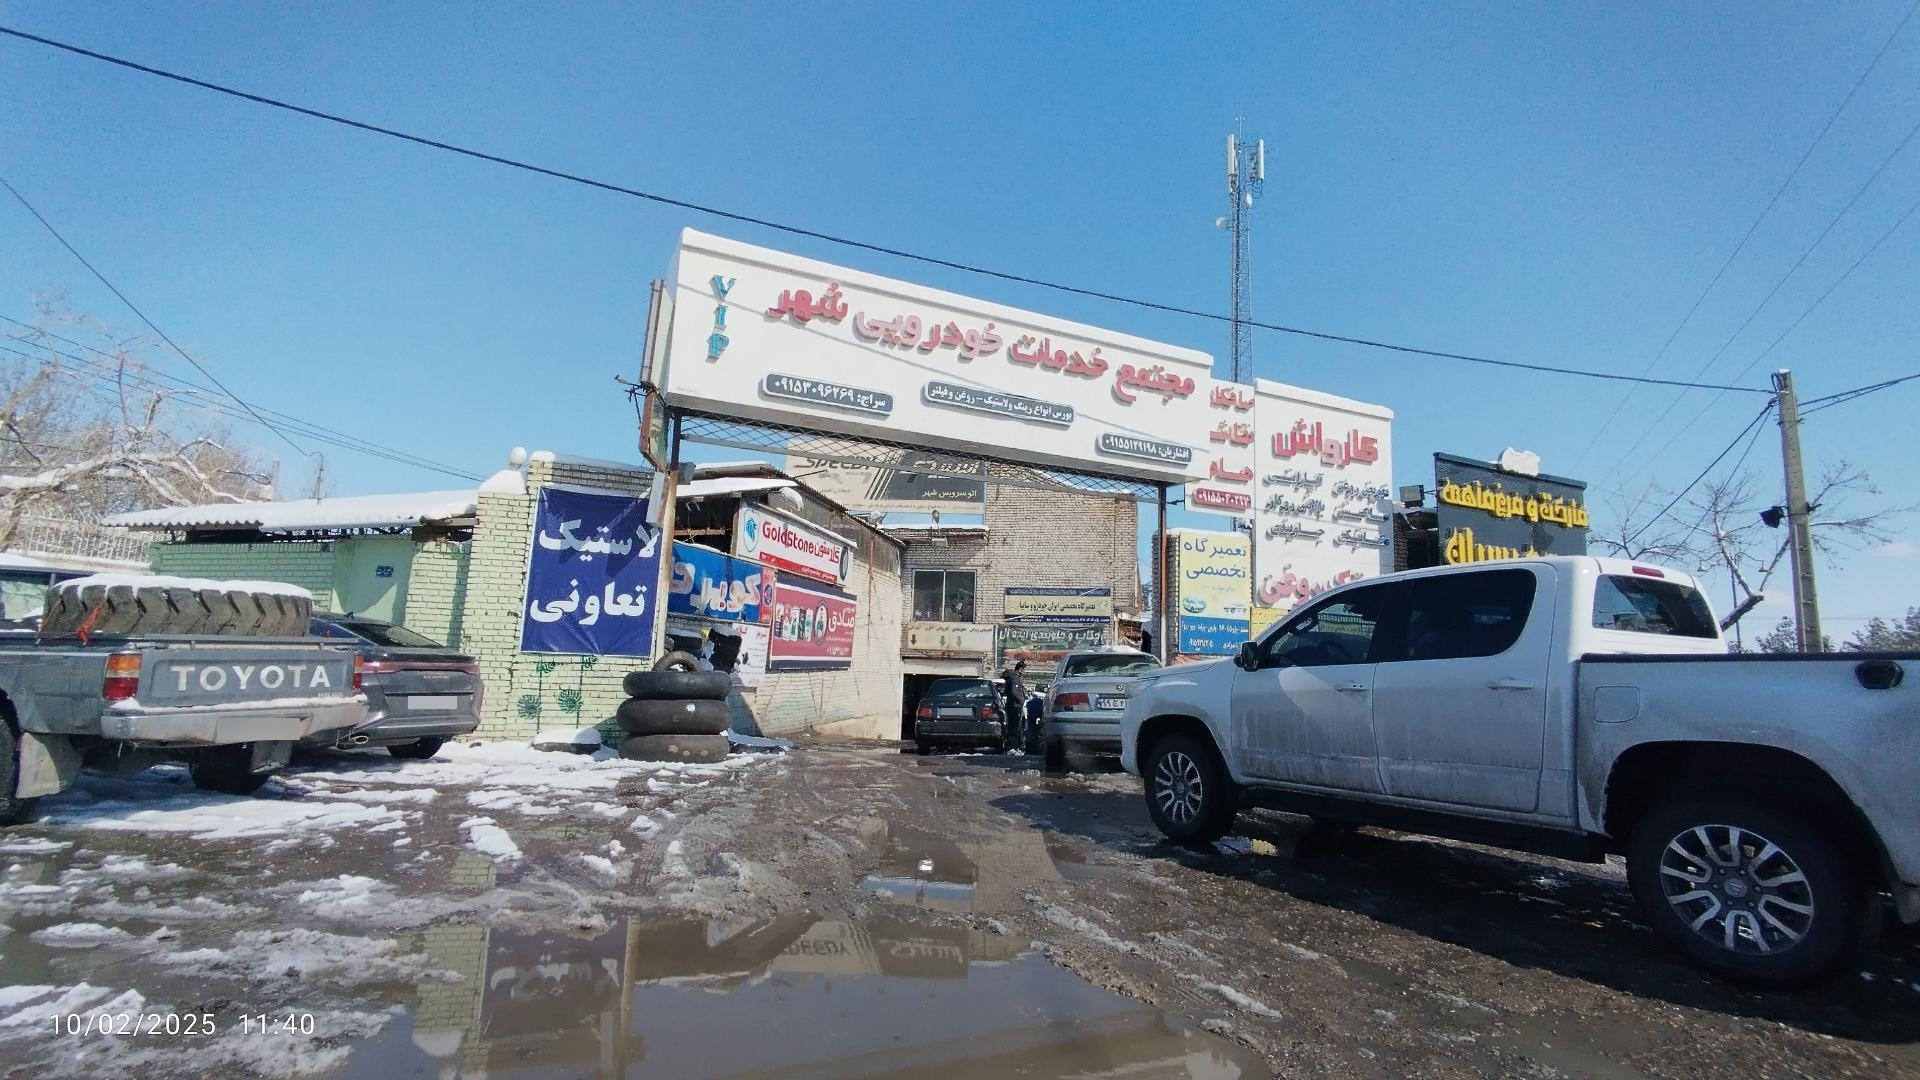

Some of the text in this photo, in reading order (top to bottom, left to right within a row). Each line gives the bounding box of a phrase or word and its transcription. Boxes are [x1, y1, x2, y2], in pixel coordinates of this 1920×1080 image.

[709, 274, 736, 359] VIP
[768, 282, 849, 322] شهر
[1010, 334, 1109, 376] خدمات
[1116, 364, 1196, 402] مجتمع
[1033, 405, 1052, 416] انواع
[1274, 417, 1378, 466] کارواش
[921, 489, 938, 498] شهر
[938, 490, 967, 499] سرویس
[539, 519, 660, 561] لاستیک
[763, 521, 814, 554] GoldStone
[1186, 564, 1246, 579] تخصصی
[530, 578, 648, 625] تعاونی
[170, 664, 331, 692] TOYOTA
